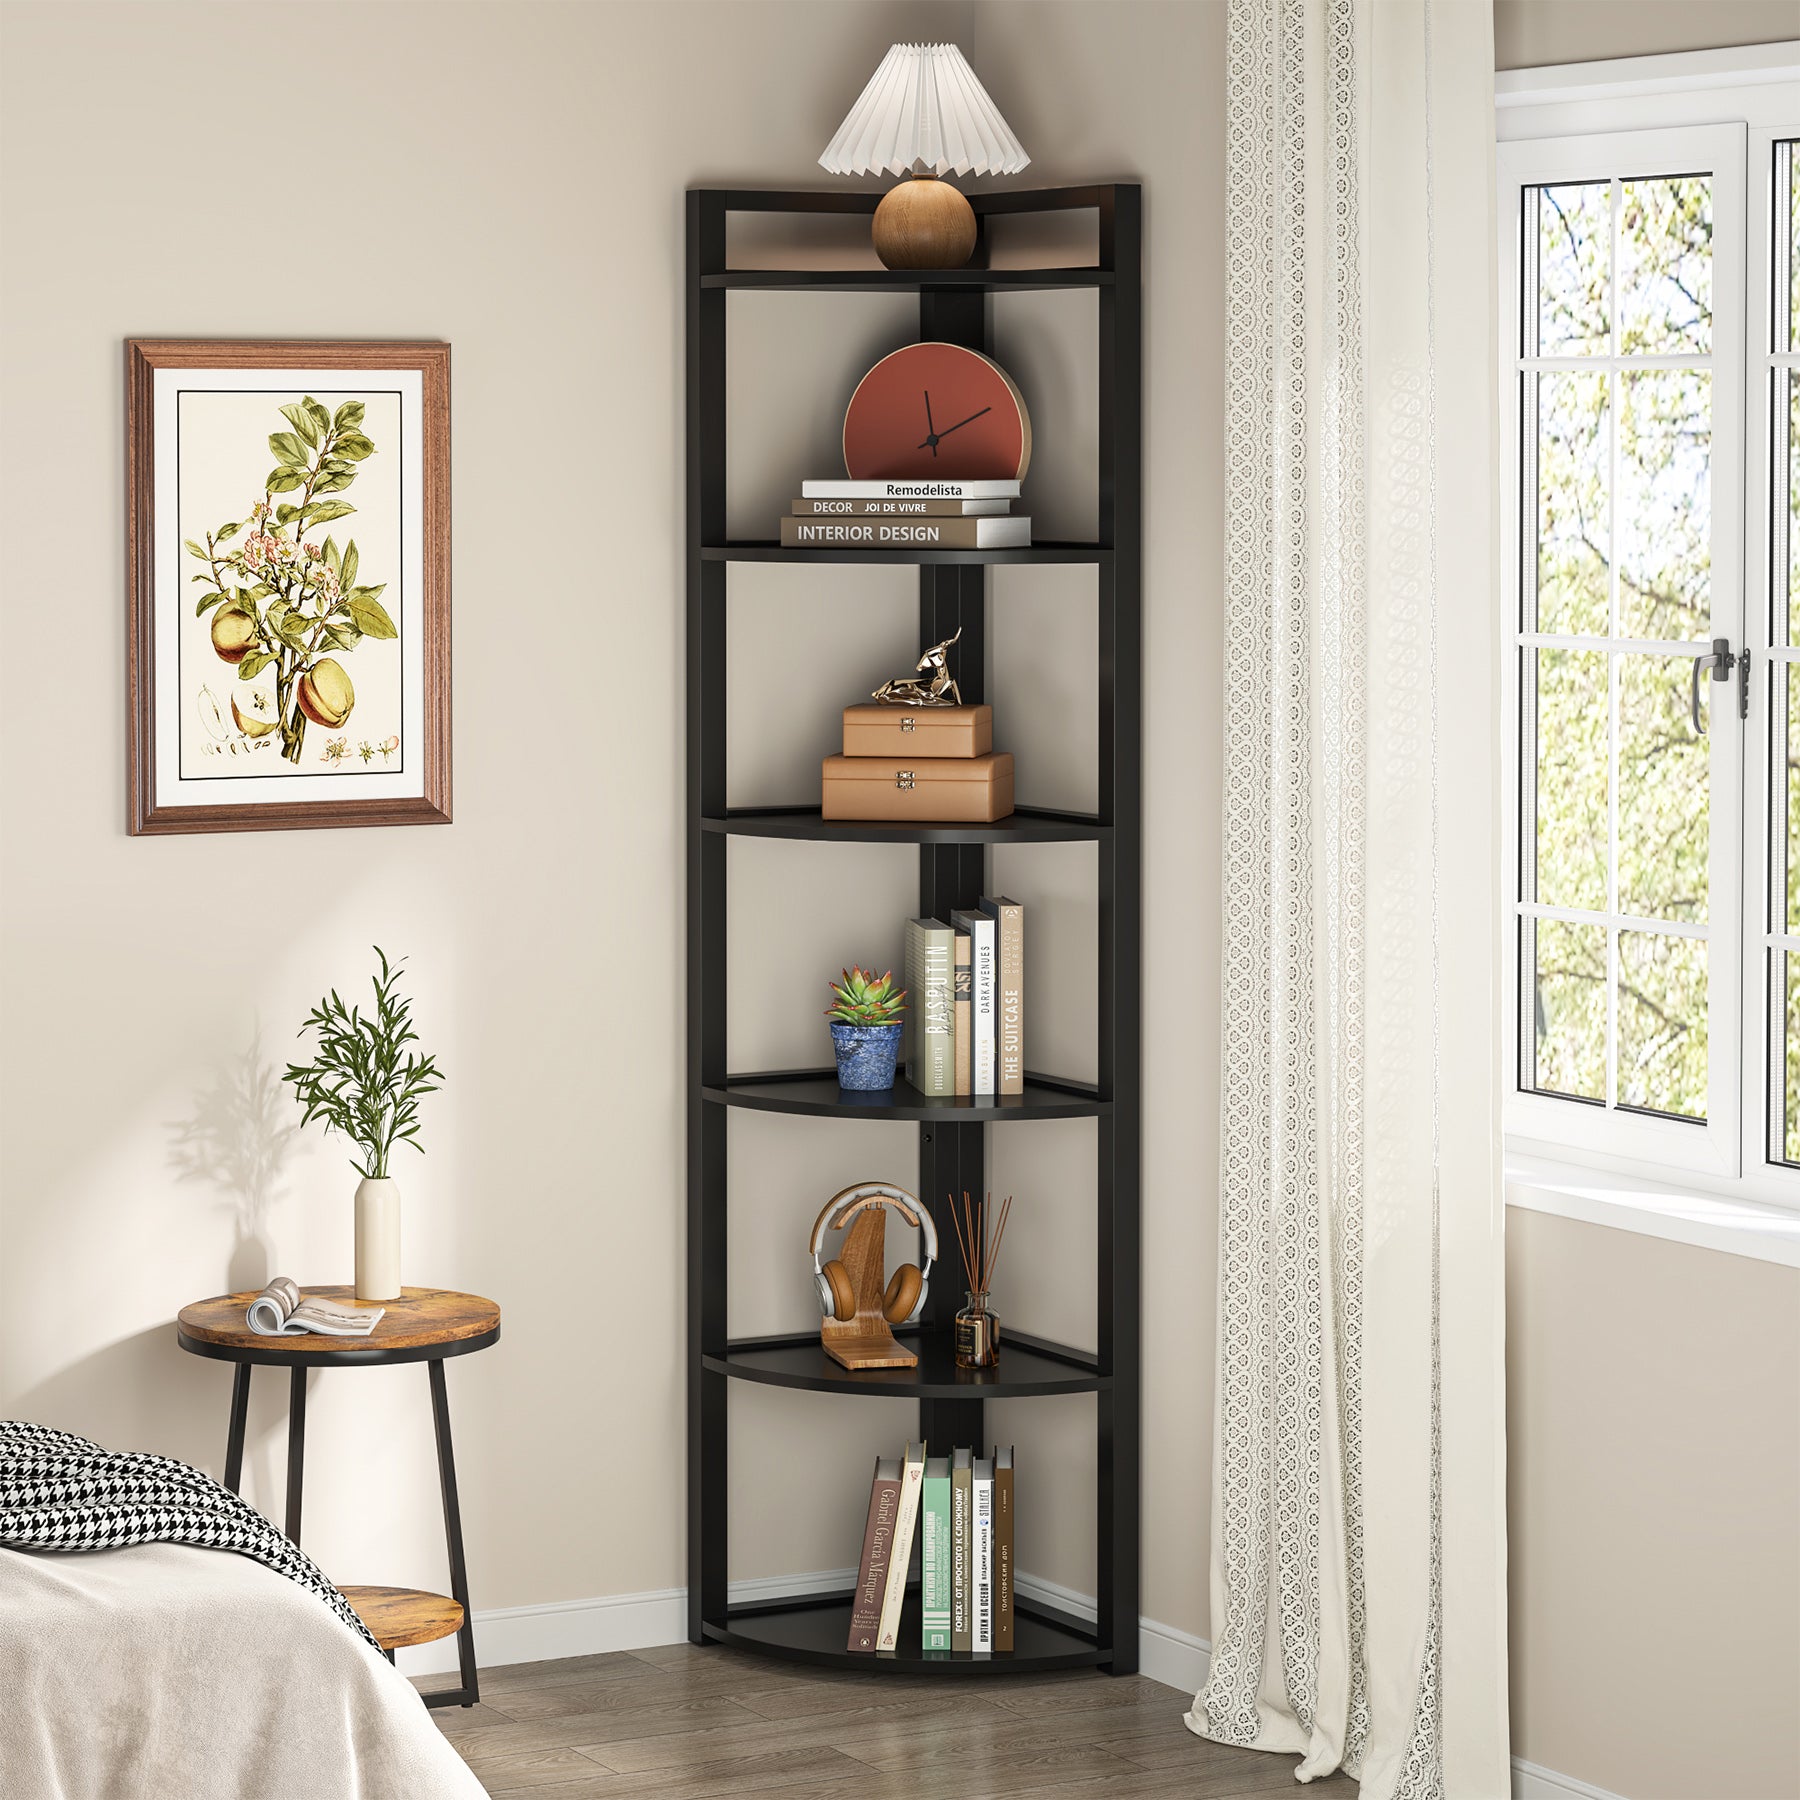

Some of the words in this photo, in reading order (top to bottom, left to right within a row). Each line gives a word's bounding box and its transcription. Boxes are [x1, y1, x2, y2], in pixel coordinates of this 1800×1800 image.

[886, 484, 963, 497] Remodelista
[813, 502, 853, 513] DECOR
[864, 503, 880, 512] JOI
[883, 503, 896, 512] DE
[898, 503, 927, 512] VIVRE
[797, 525, 874, 541] INTERIOR
[879, 526, 940, 541] DESIGN
[980, 945, 990, 987] AVENUES
[925, 946, 948, 1034] RASPUTIN
[980, 989, 990, 1014] DARK
[1005, 990, 1018, 1052] SUITCASE
[1005, 1056, 1018, 1080] THE
[877, 1489, 896, 1524] Gabriel
[955, 1487, 963, 1536] СЛОЖНОМУ
[873, 1527, 889, 1559] García
[955, 1545, 963, 1586] ПРОСТОГО
[863, 1562, 884, 1604] Márquez
[955, 1587, 963, 1598] ОТ
[979, 1583, 989, 1607] ОСЕВОЙ
[955, 1601, 963, 1633] FOREX:
[980, 1608, 989, 1617] НА
[980, 1619, 989, 1643] ПРЯТКИ
